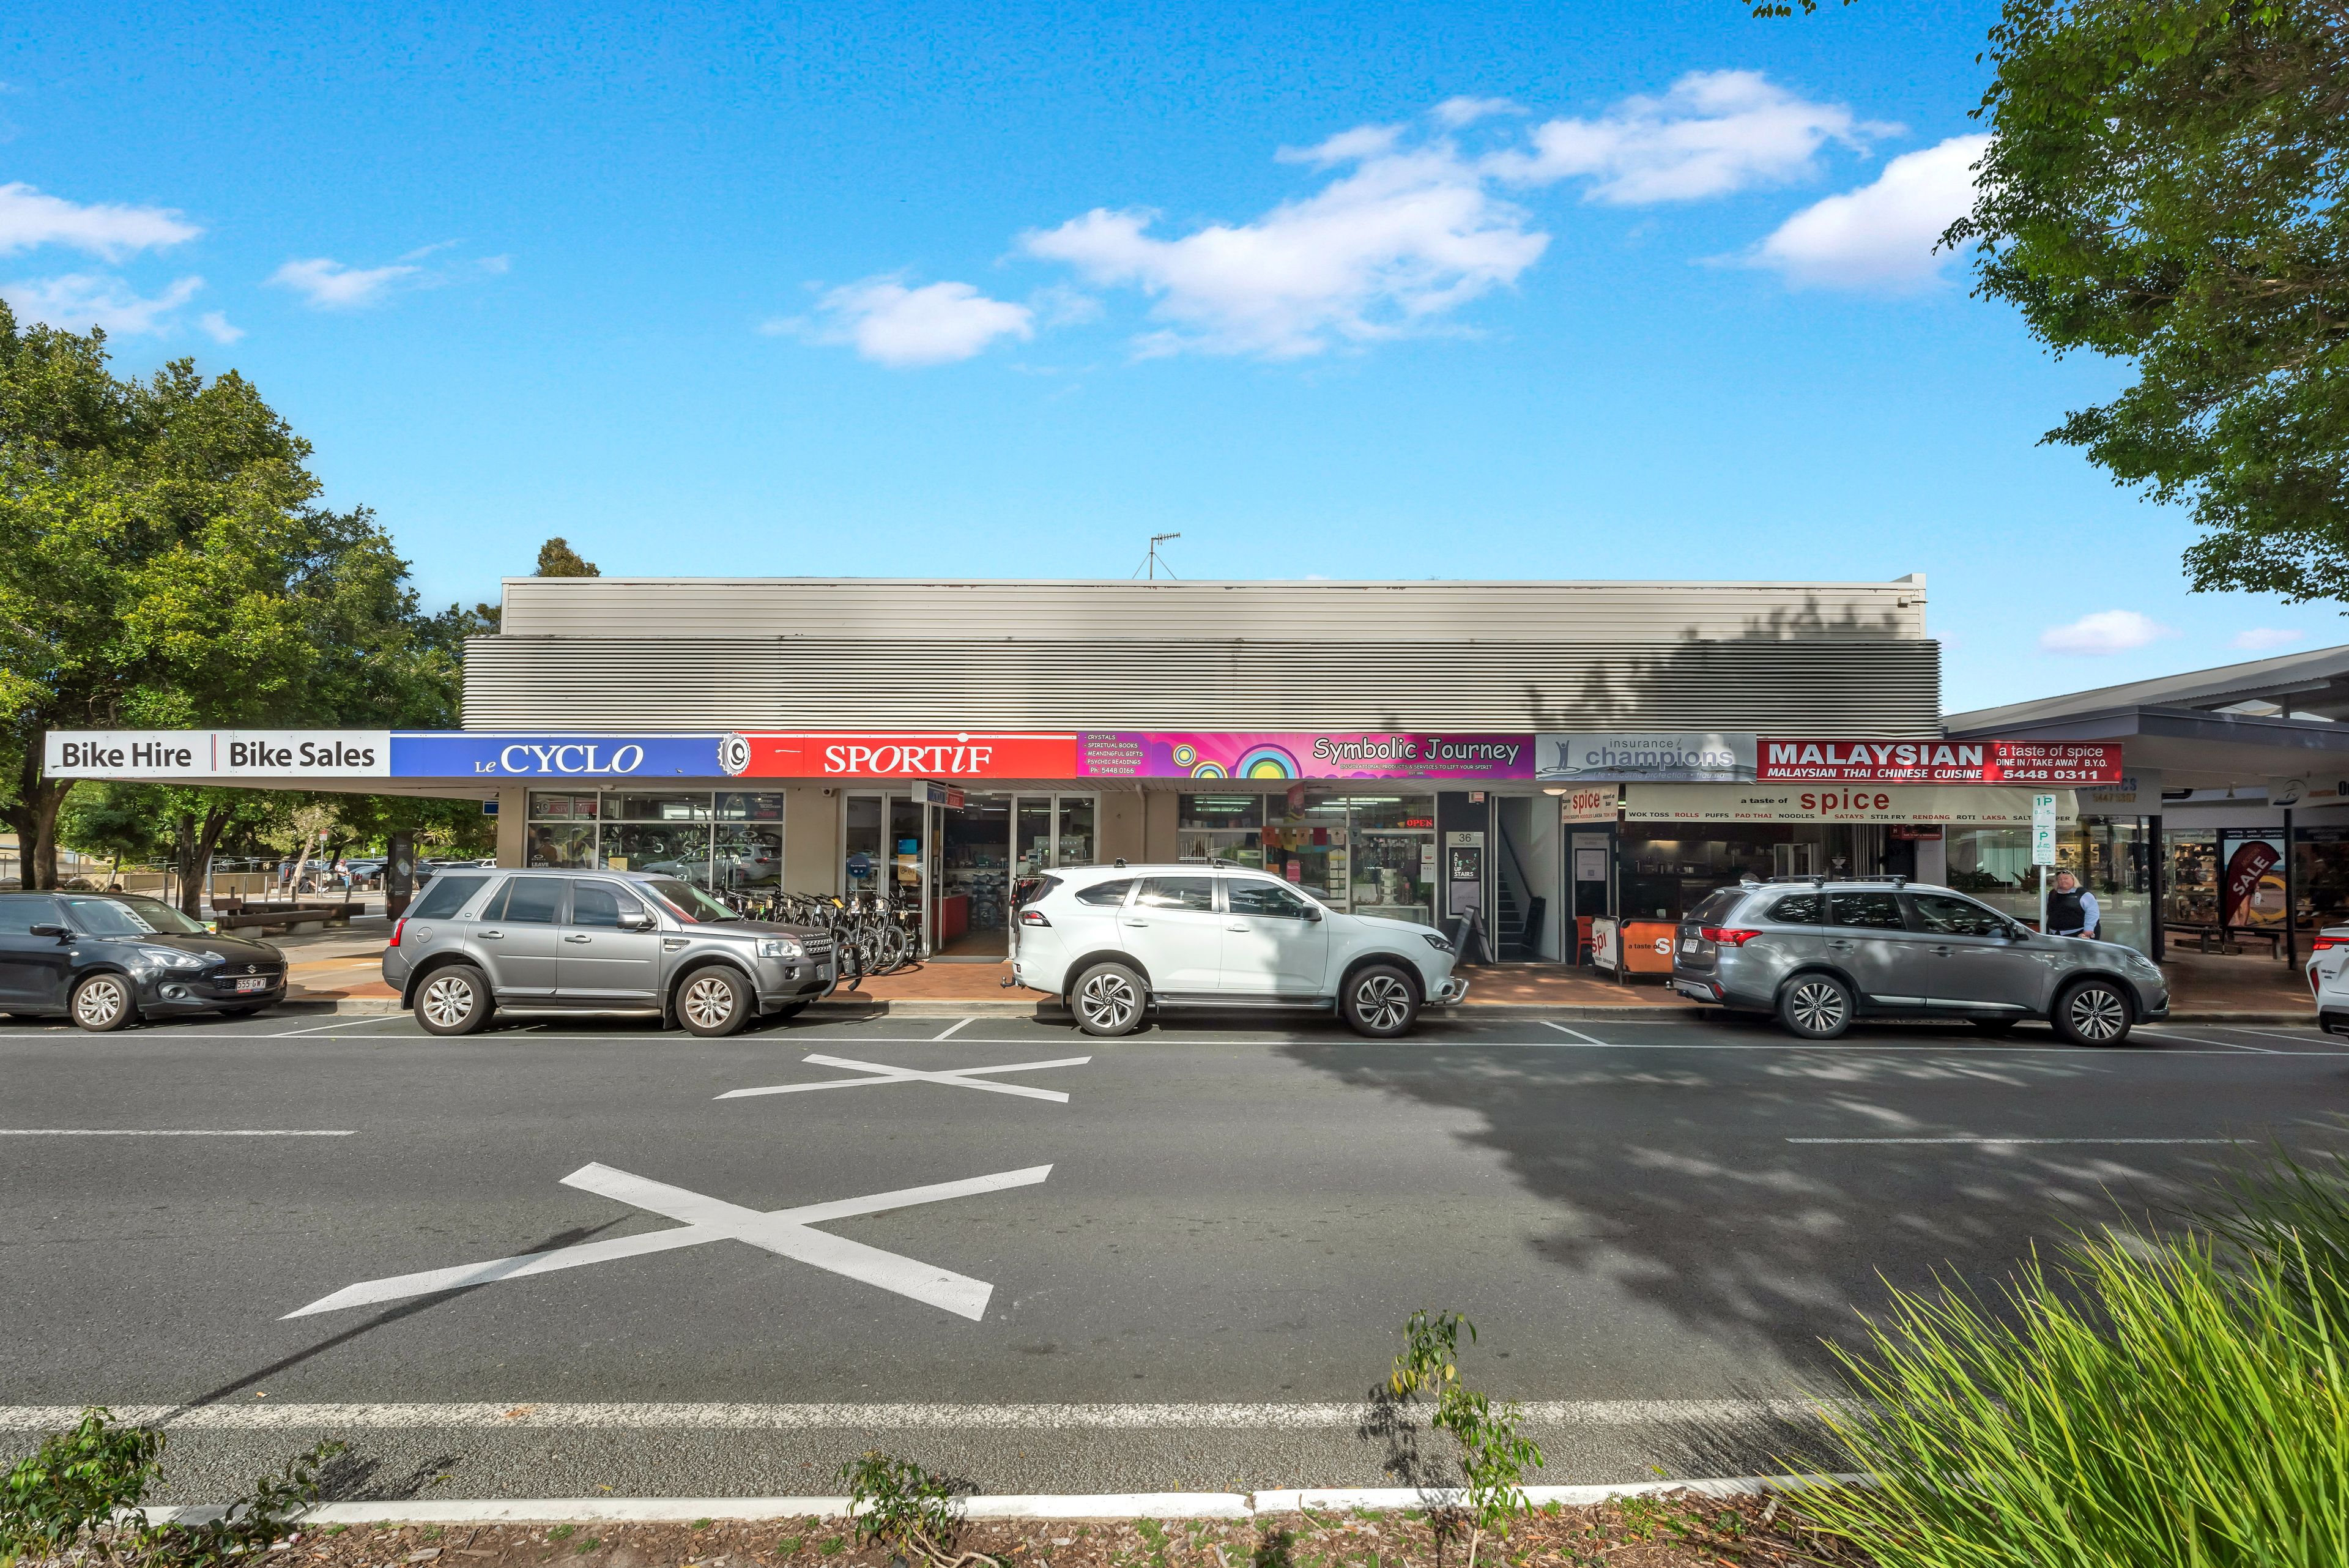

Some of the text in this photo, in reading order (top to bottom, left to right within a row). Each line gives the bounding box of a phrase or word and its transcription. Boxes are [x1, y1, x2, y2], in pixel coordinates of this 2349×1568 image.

[62, 742, 191, 767] Bike Hire
[230, 741, 375, 767] Bike Sales
[1313, 737, 1520, 765] Symbolic Journey
[1610, 738, 1673, 748] insurance
[1998, 745, 2103, 759] a taste of spice
[501, 745, 644, 773] CYCLO
[1586, 747, 1734, 771] champions
[1768, 744, 1983, 766] MALAYSIAN
[1767, 768, 1983, 779] MALAYSIAN THAI CHINESE CUISINE
[2003, 770, 2098, 779] 5448 0311
[1573, 789, 1600, 814] spice
[1800, 788, 1890, 815] spice
[2036, 797, 2052, 806] 1P
[1407, 819, 1433, 827] OPEN
[2039, 832, 2049, 841] P
[2233, 855, 2270, 896] SALE
